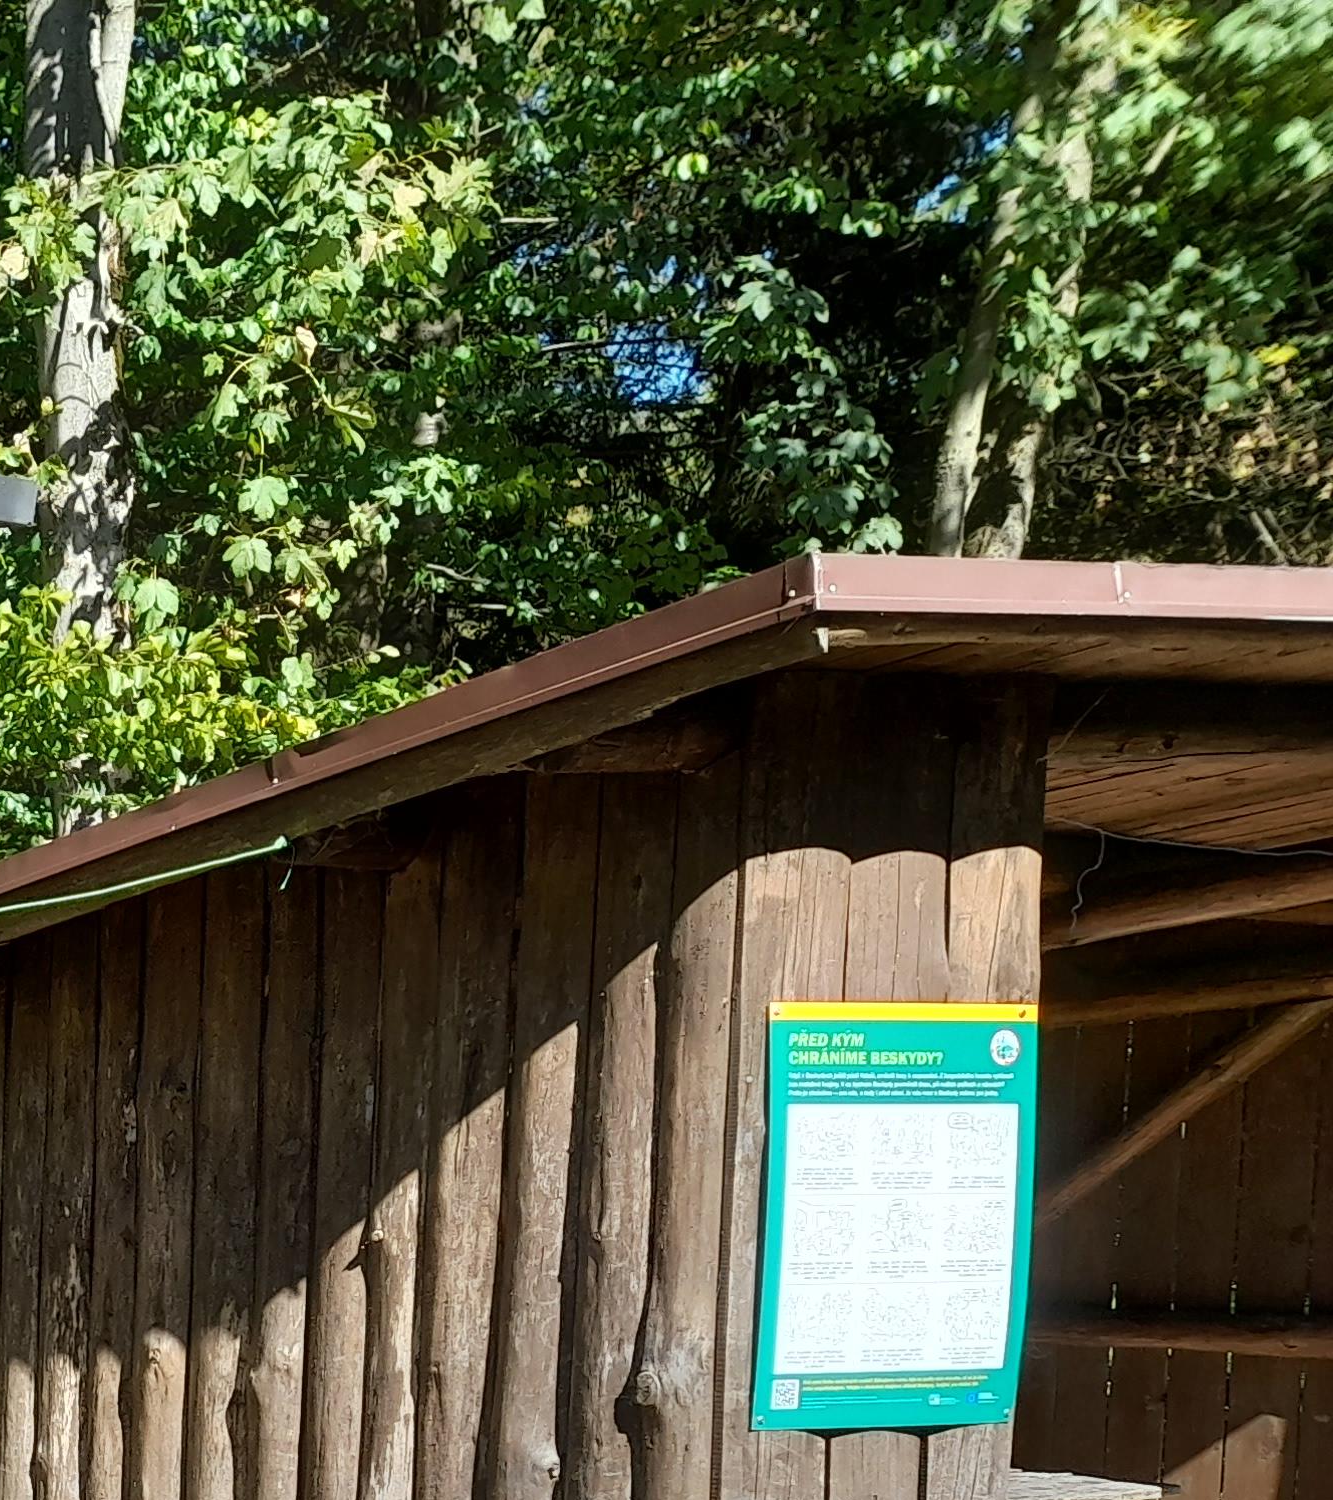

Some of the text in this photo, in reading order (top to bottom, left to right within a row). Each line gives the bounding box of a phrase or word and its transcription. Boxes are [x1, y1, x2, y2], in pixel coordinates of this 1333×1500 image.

[788, 1028, 865, 1047] PŘED KÝM
[788, 1047, 944, 1066] CHRÁNÍME BESKYDY?
